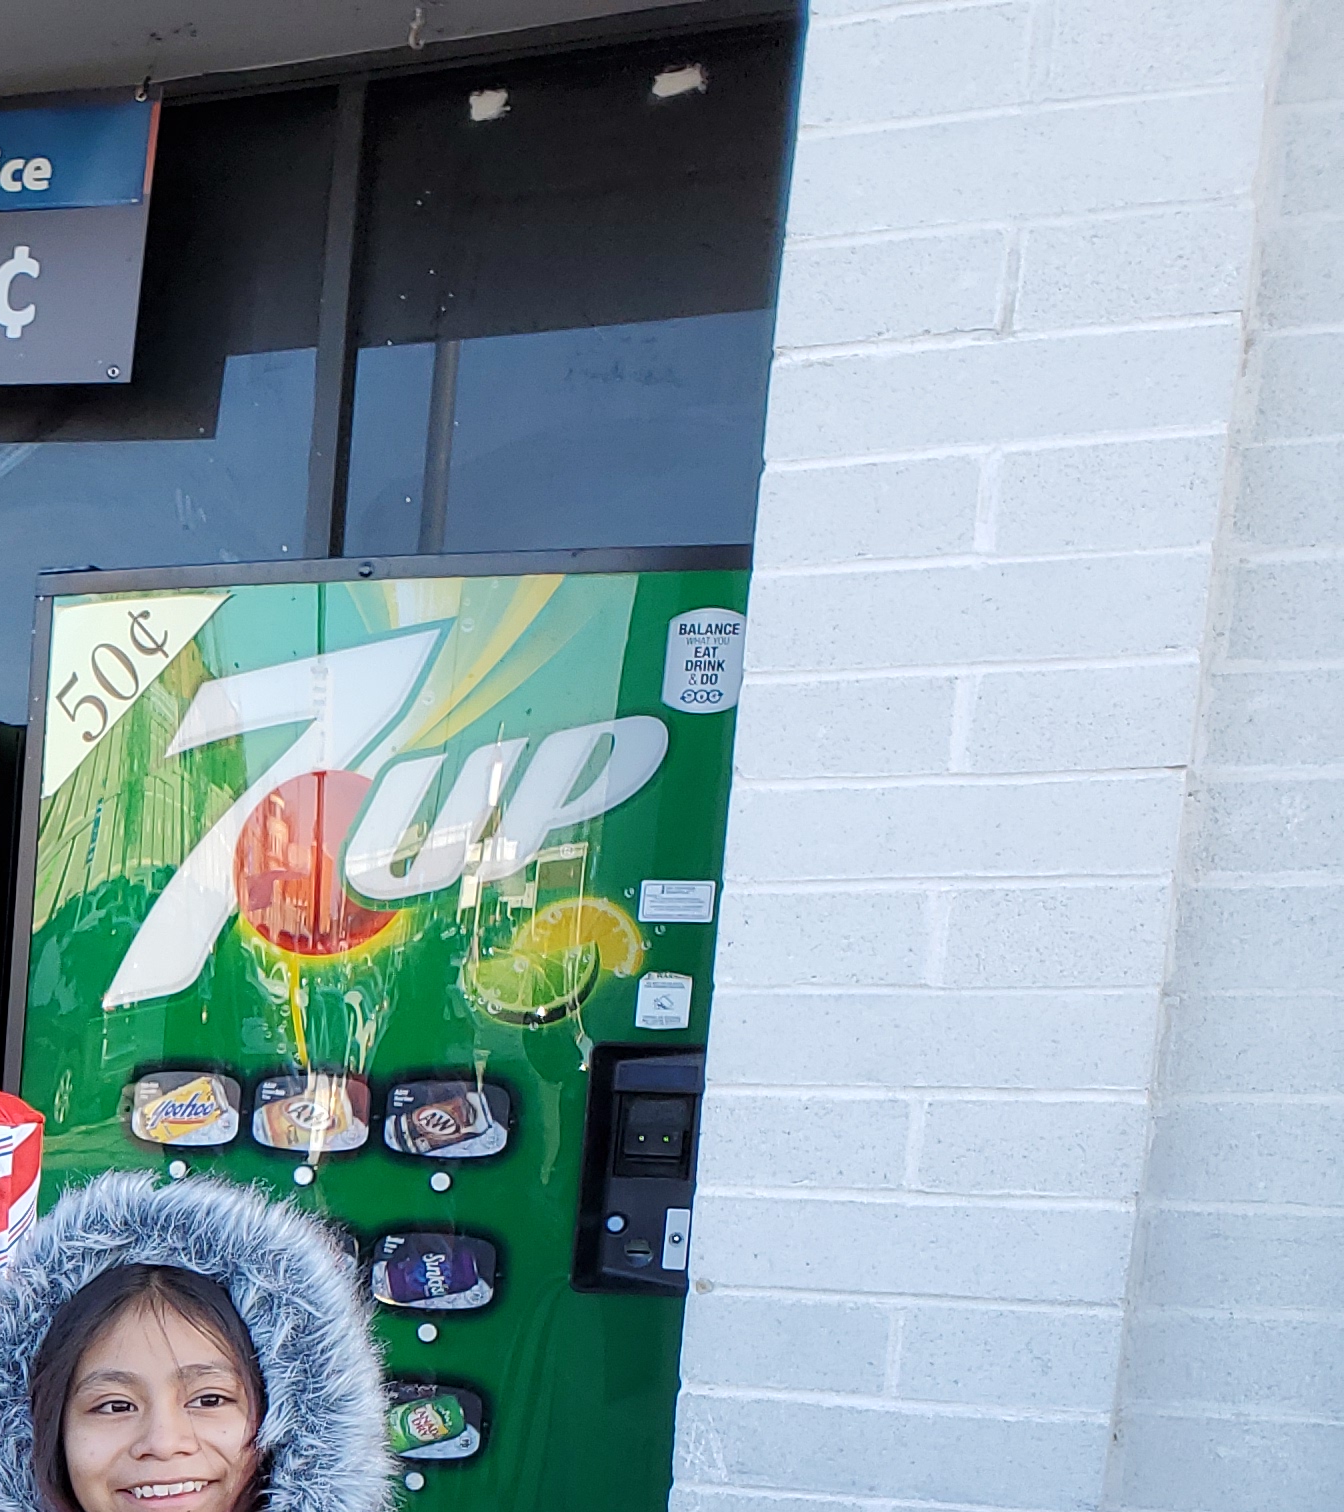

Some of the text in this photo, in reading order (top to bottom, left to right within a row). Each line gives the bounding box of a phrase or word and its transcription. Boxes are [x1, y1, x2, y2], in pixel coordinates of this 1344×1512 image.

[678, 622, 741, 636] BALANCE
[686, 636, 731, 646] WHAT YOU
[694, 646, 718, 659] EAT
[685, 659, 726, 672] DRINK
[54, 608, 170, 744] 50¢
[688, 673, 719, 686] & DO
